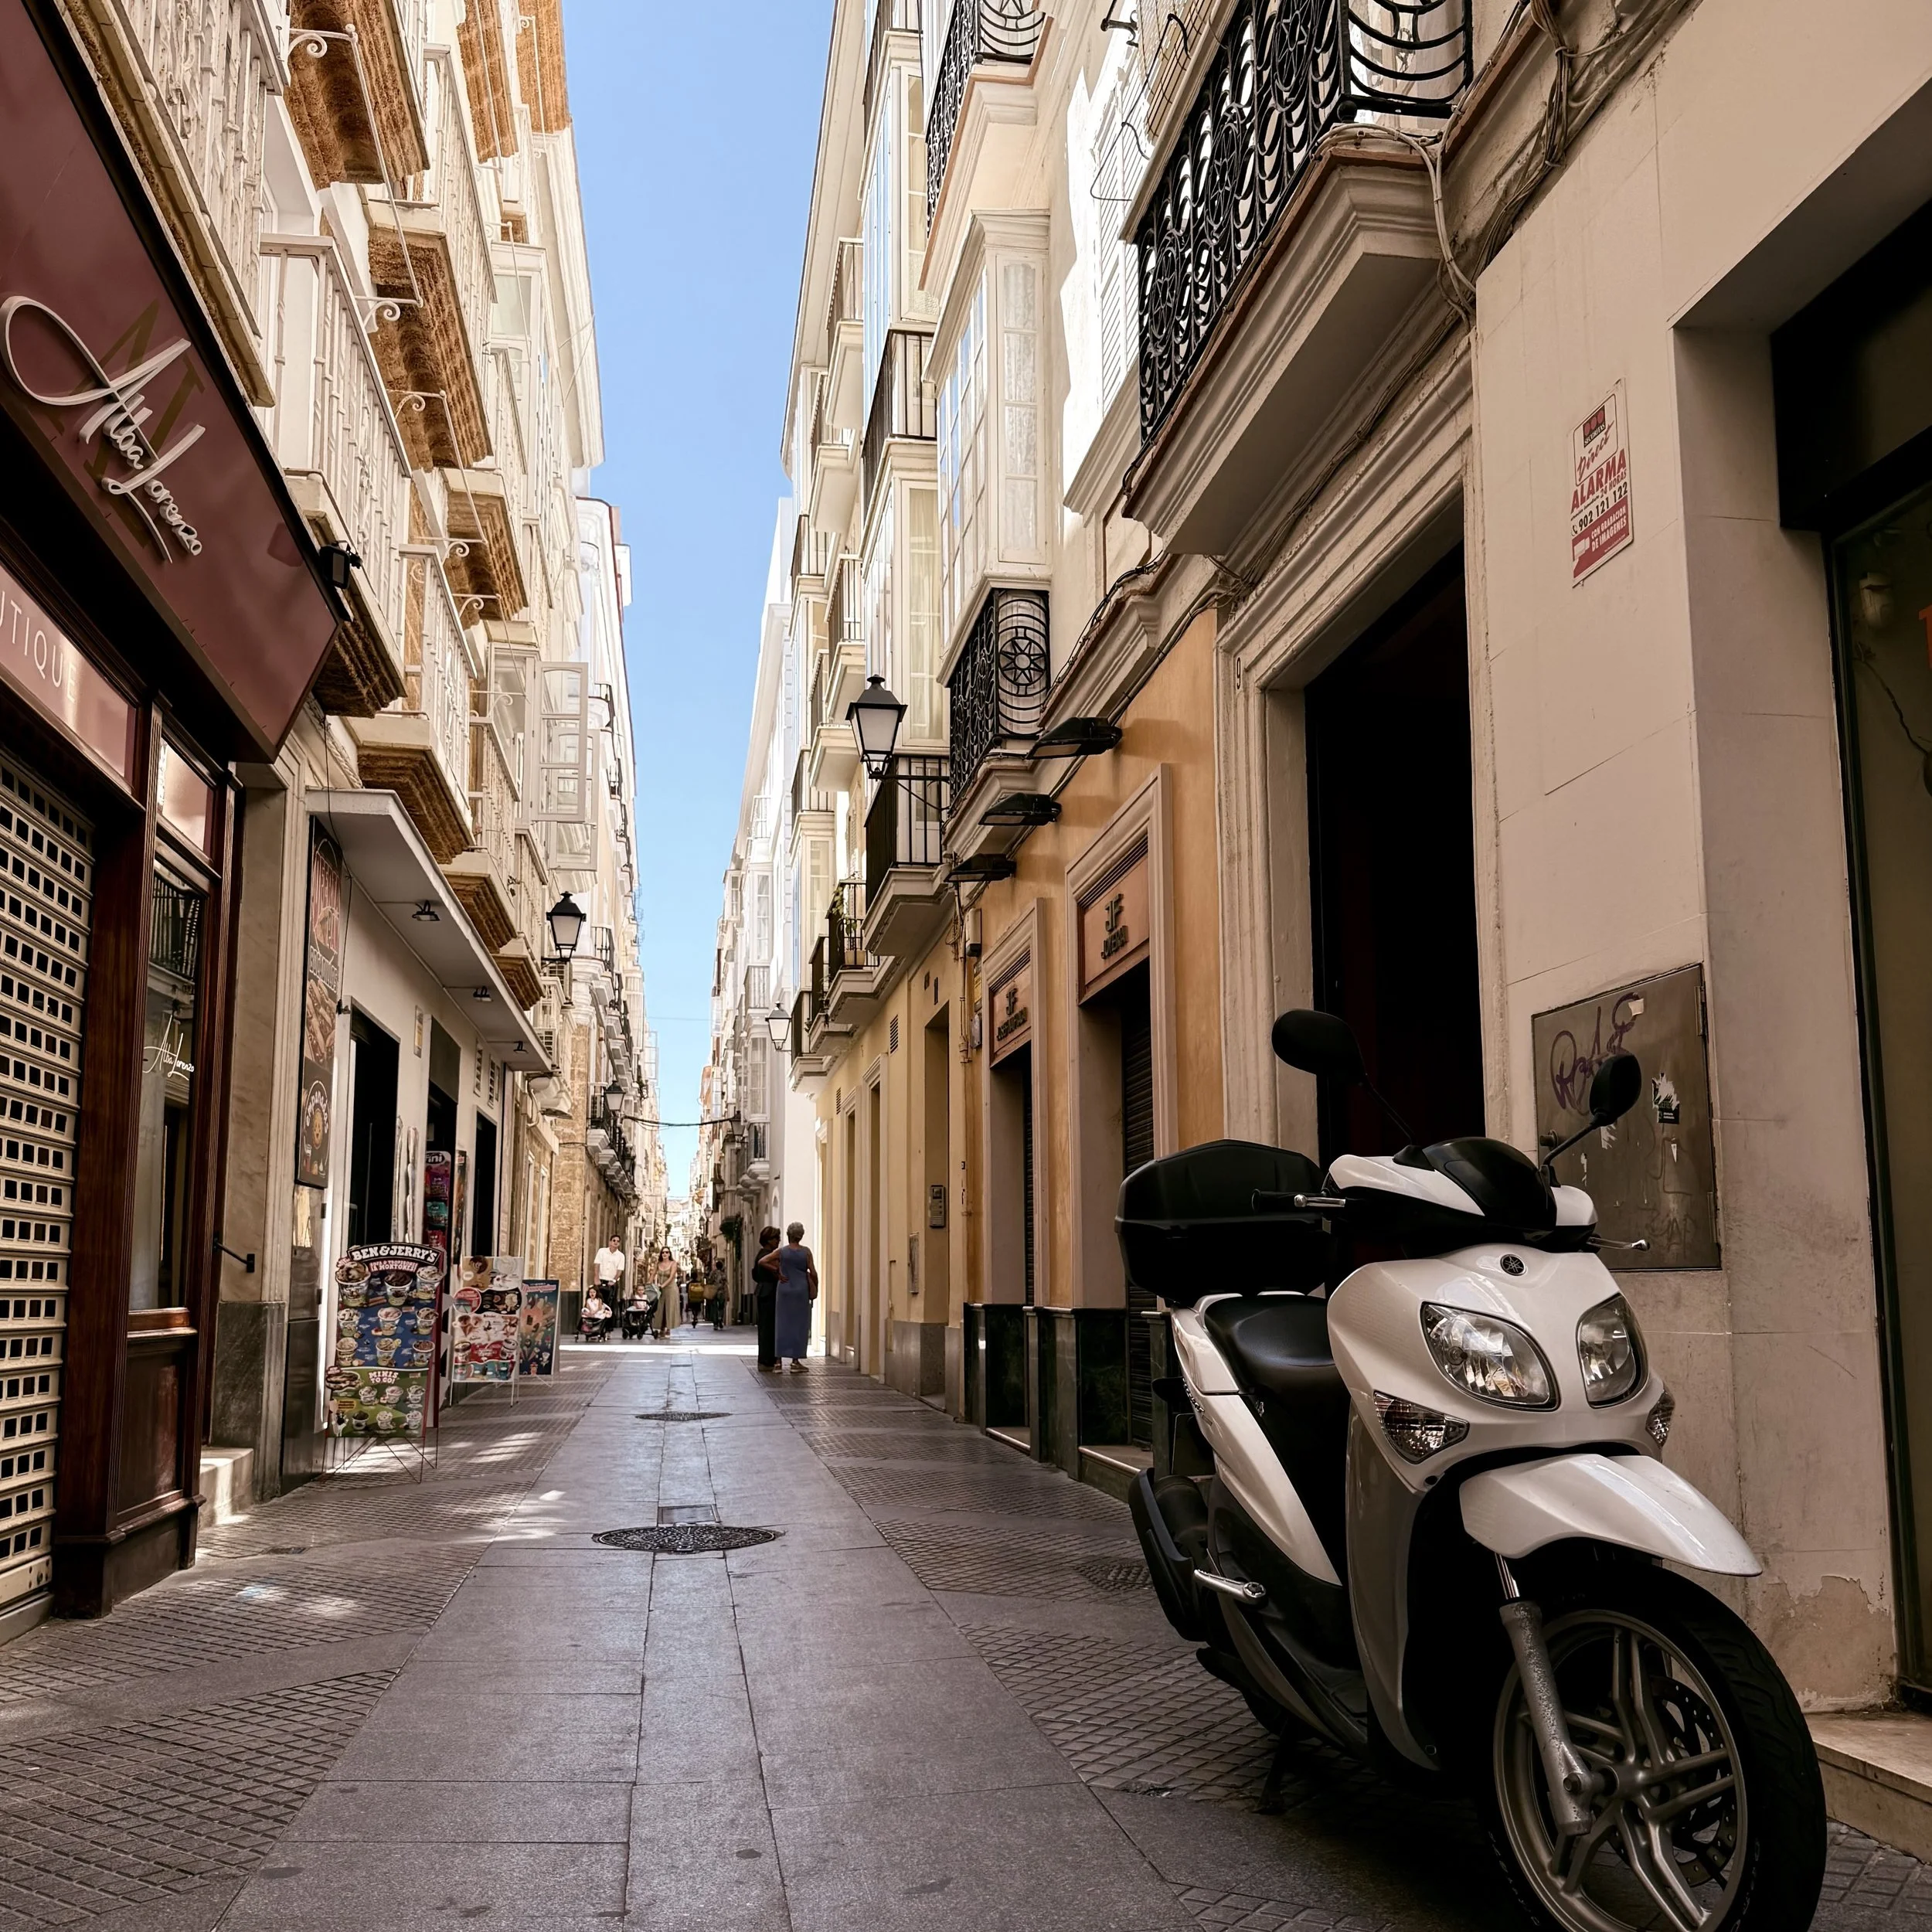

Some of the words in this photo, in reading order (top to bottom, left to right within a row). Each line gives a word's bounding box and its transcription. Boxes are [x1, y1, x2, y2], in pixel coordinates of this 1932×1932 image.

[0, 295, 192, 469] Alba
[101, 424, 206, 564] Lorenzo
[1584, 423, 1605, 447] SECURITAS
[1577, 420, 1615, 481] Direct
[1570, 448, 1627, 515] ALARMA
[1600, 485, 1608, 499] 24
[1609, 468, 1627, 492] HORAS
[1579, 510, 1594, 532] 902
[1596, 497, 1609, 517] 121
[1613, 481, 1628, 503] 122
[1591, 524, 1600, 539] CON
[1591, 539, 1599, 553] DE
[1600, 517, 1627, 546] IMAGENES
[306, 1090, 328, 1134] empanadas
[369, 1370, 399, 1380] MINIS
[383, 1376, 396, 1385] GO!
